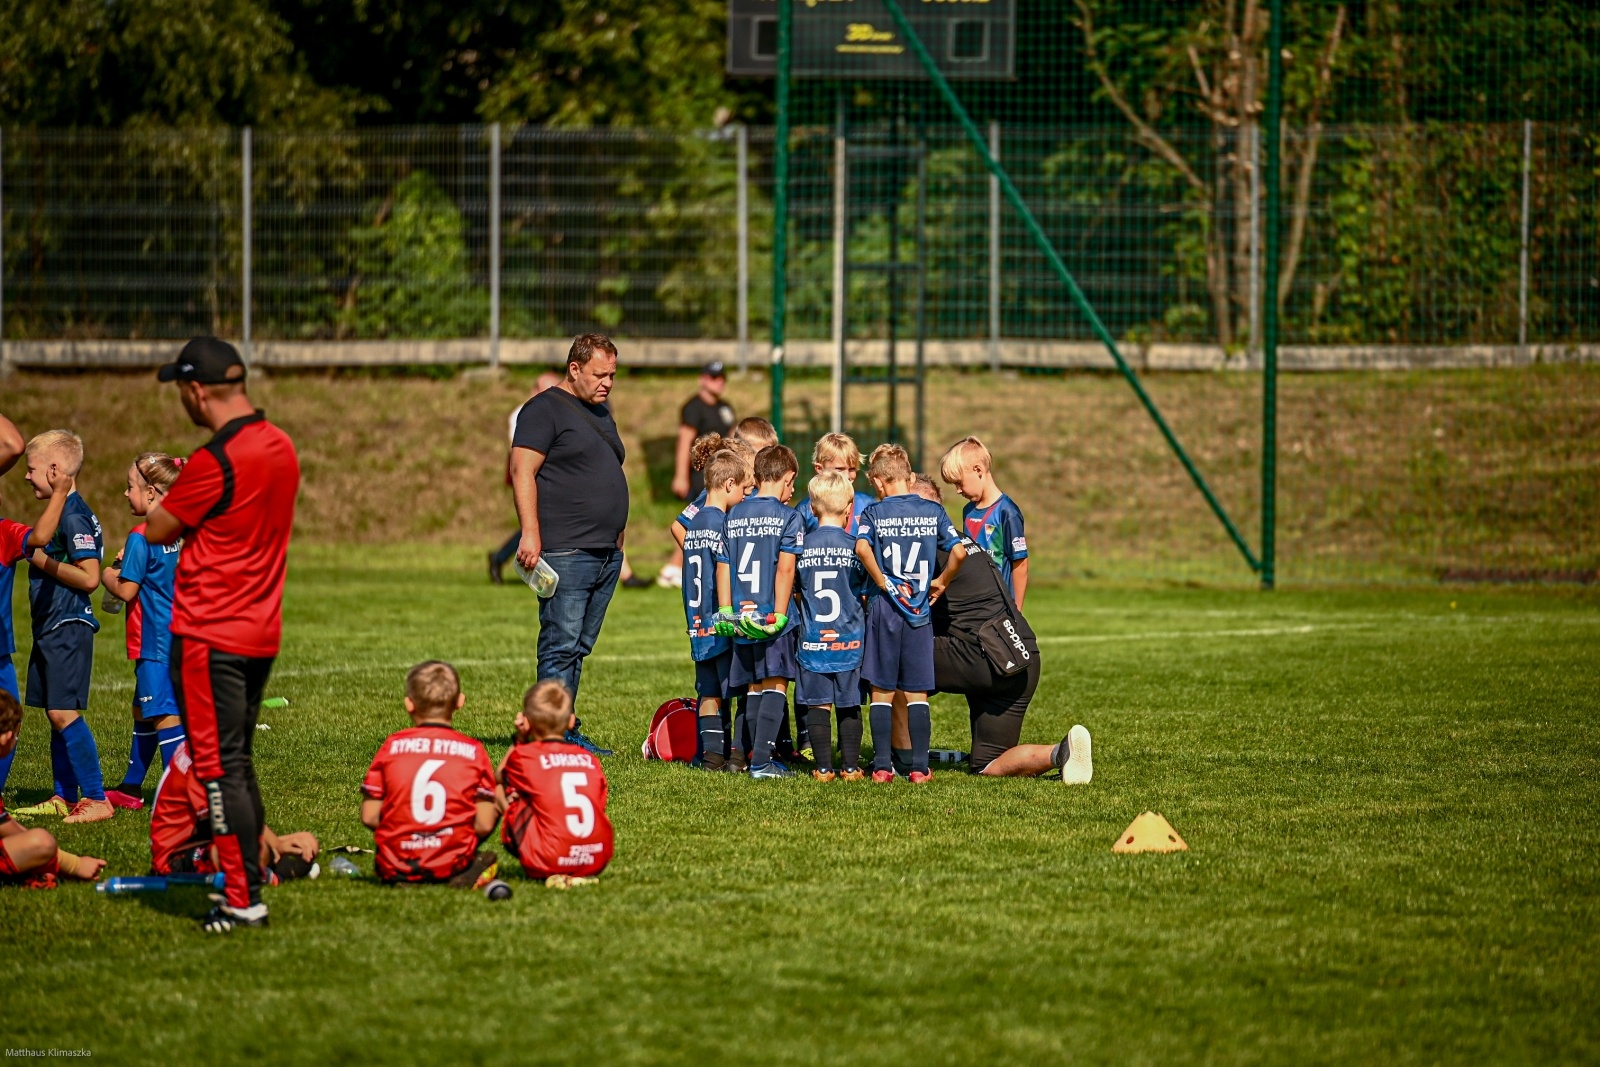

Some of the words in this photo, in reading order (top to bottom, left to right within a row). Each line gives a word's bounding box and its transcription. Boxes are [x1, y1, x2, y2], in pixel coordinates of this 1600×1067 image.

[727, 518, 749, 528] ADEMIA
[749, 516, 785, 527] PIŁKARSKA
[746, 525, 782, 538] ŚLĄSKIE
[875, 517, 902, 527] ADEMIA
[903, 516, 938, 526] PIŁKARSK
[901, 524, 938, 538] ŚLĄSKI
[688, 555, 703, 608] 3
[737, 541, 761, 594] 4
[882, 541, 929, 592] 14
[814, 570, 841, 623] 5
[802, 640, 861, 651] GER-BUD
[1002, 618, 1030, 660] adidas
[539, 752, 596, 770] ŁUKASZ
[410, 759, 447, 826] 6
[560, 771, 595, 838] 5
